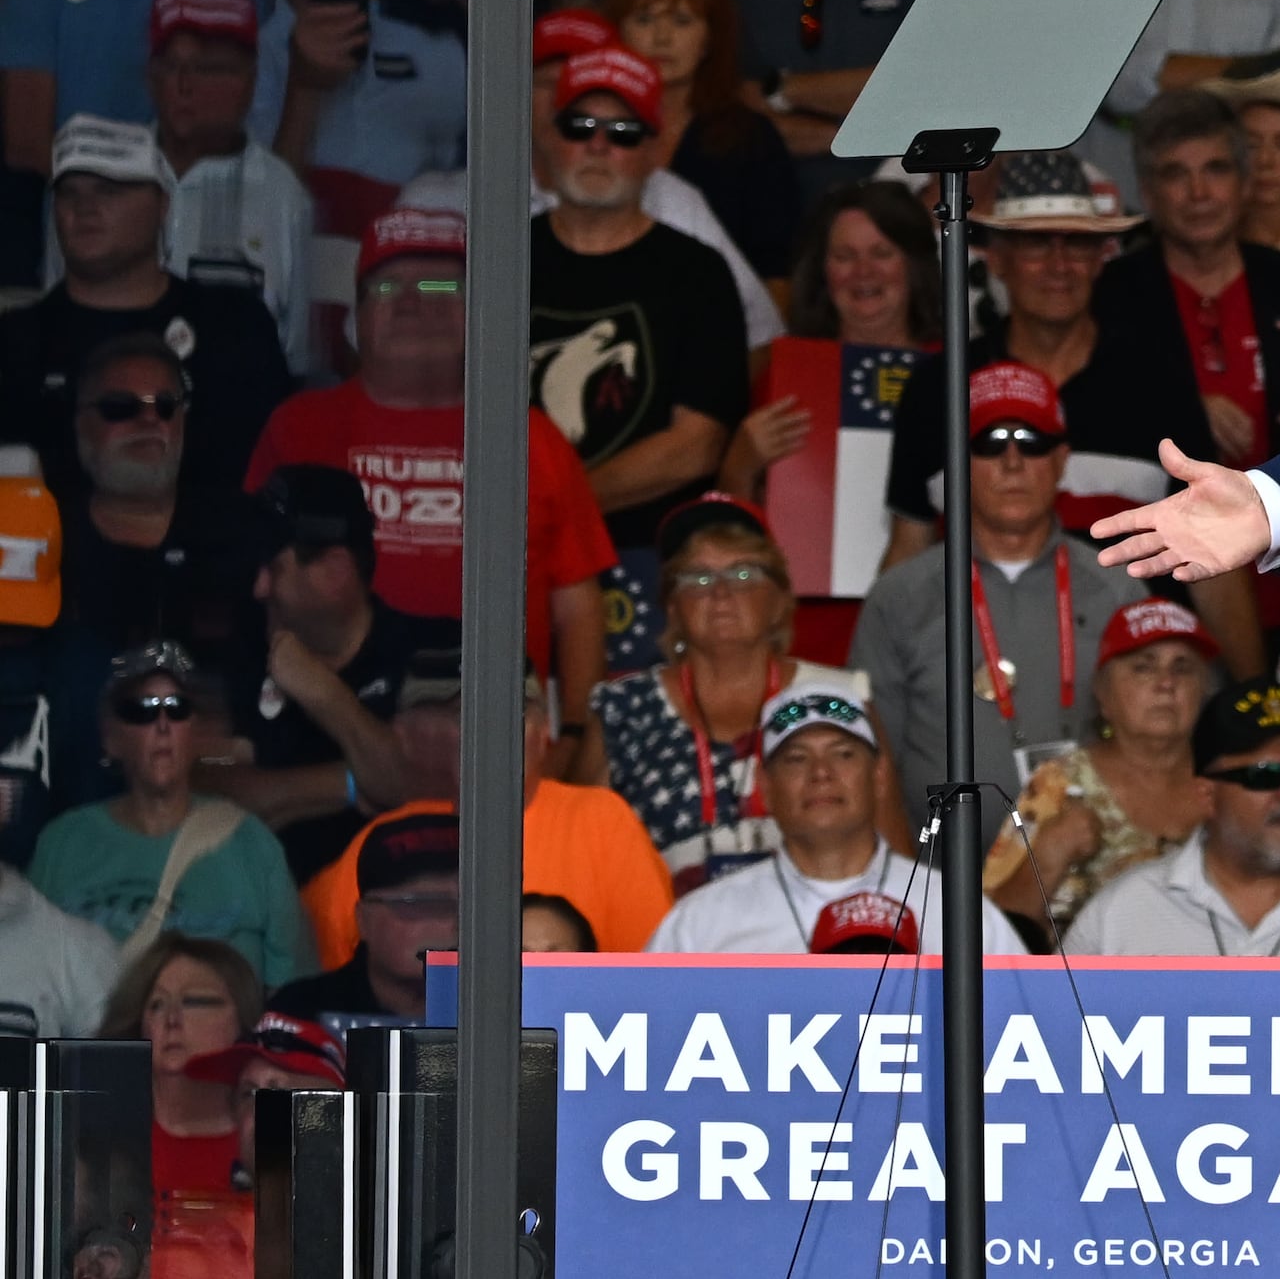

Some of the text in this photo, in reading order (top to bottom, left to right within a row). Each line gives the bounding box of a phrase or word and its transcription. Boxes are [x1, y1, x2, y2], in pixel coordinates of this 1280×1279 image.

[563, 1012, 923, 1094] MAKE
[601, 1119, 1027, 1203] GREAT
[1073, 1238, 1261, 1267] GEORGIA
